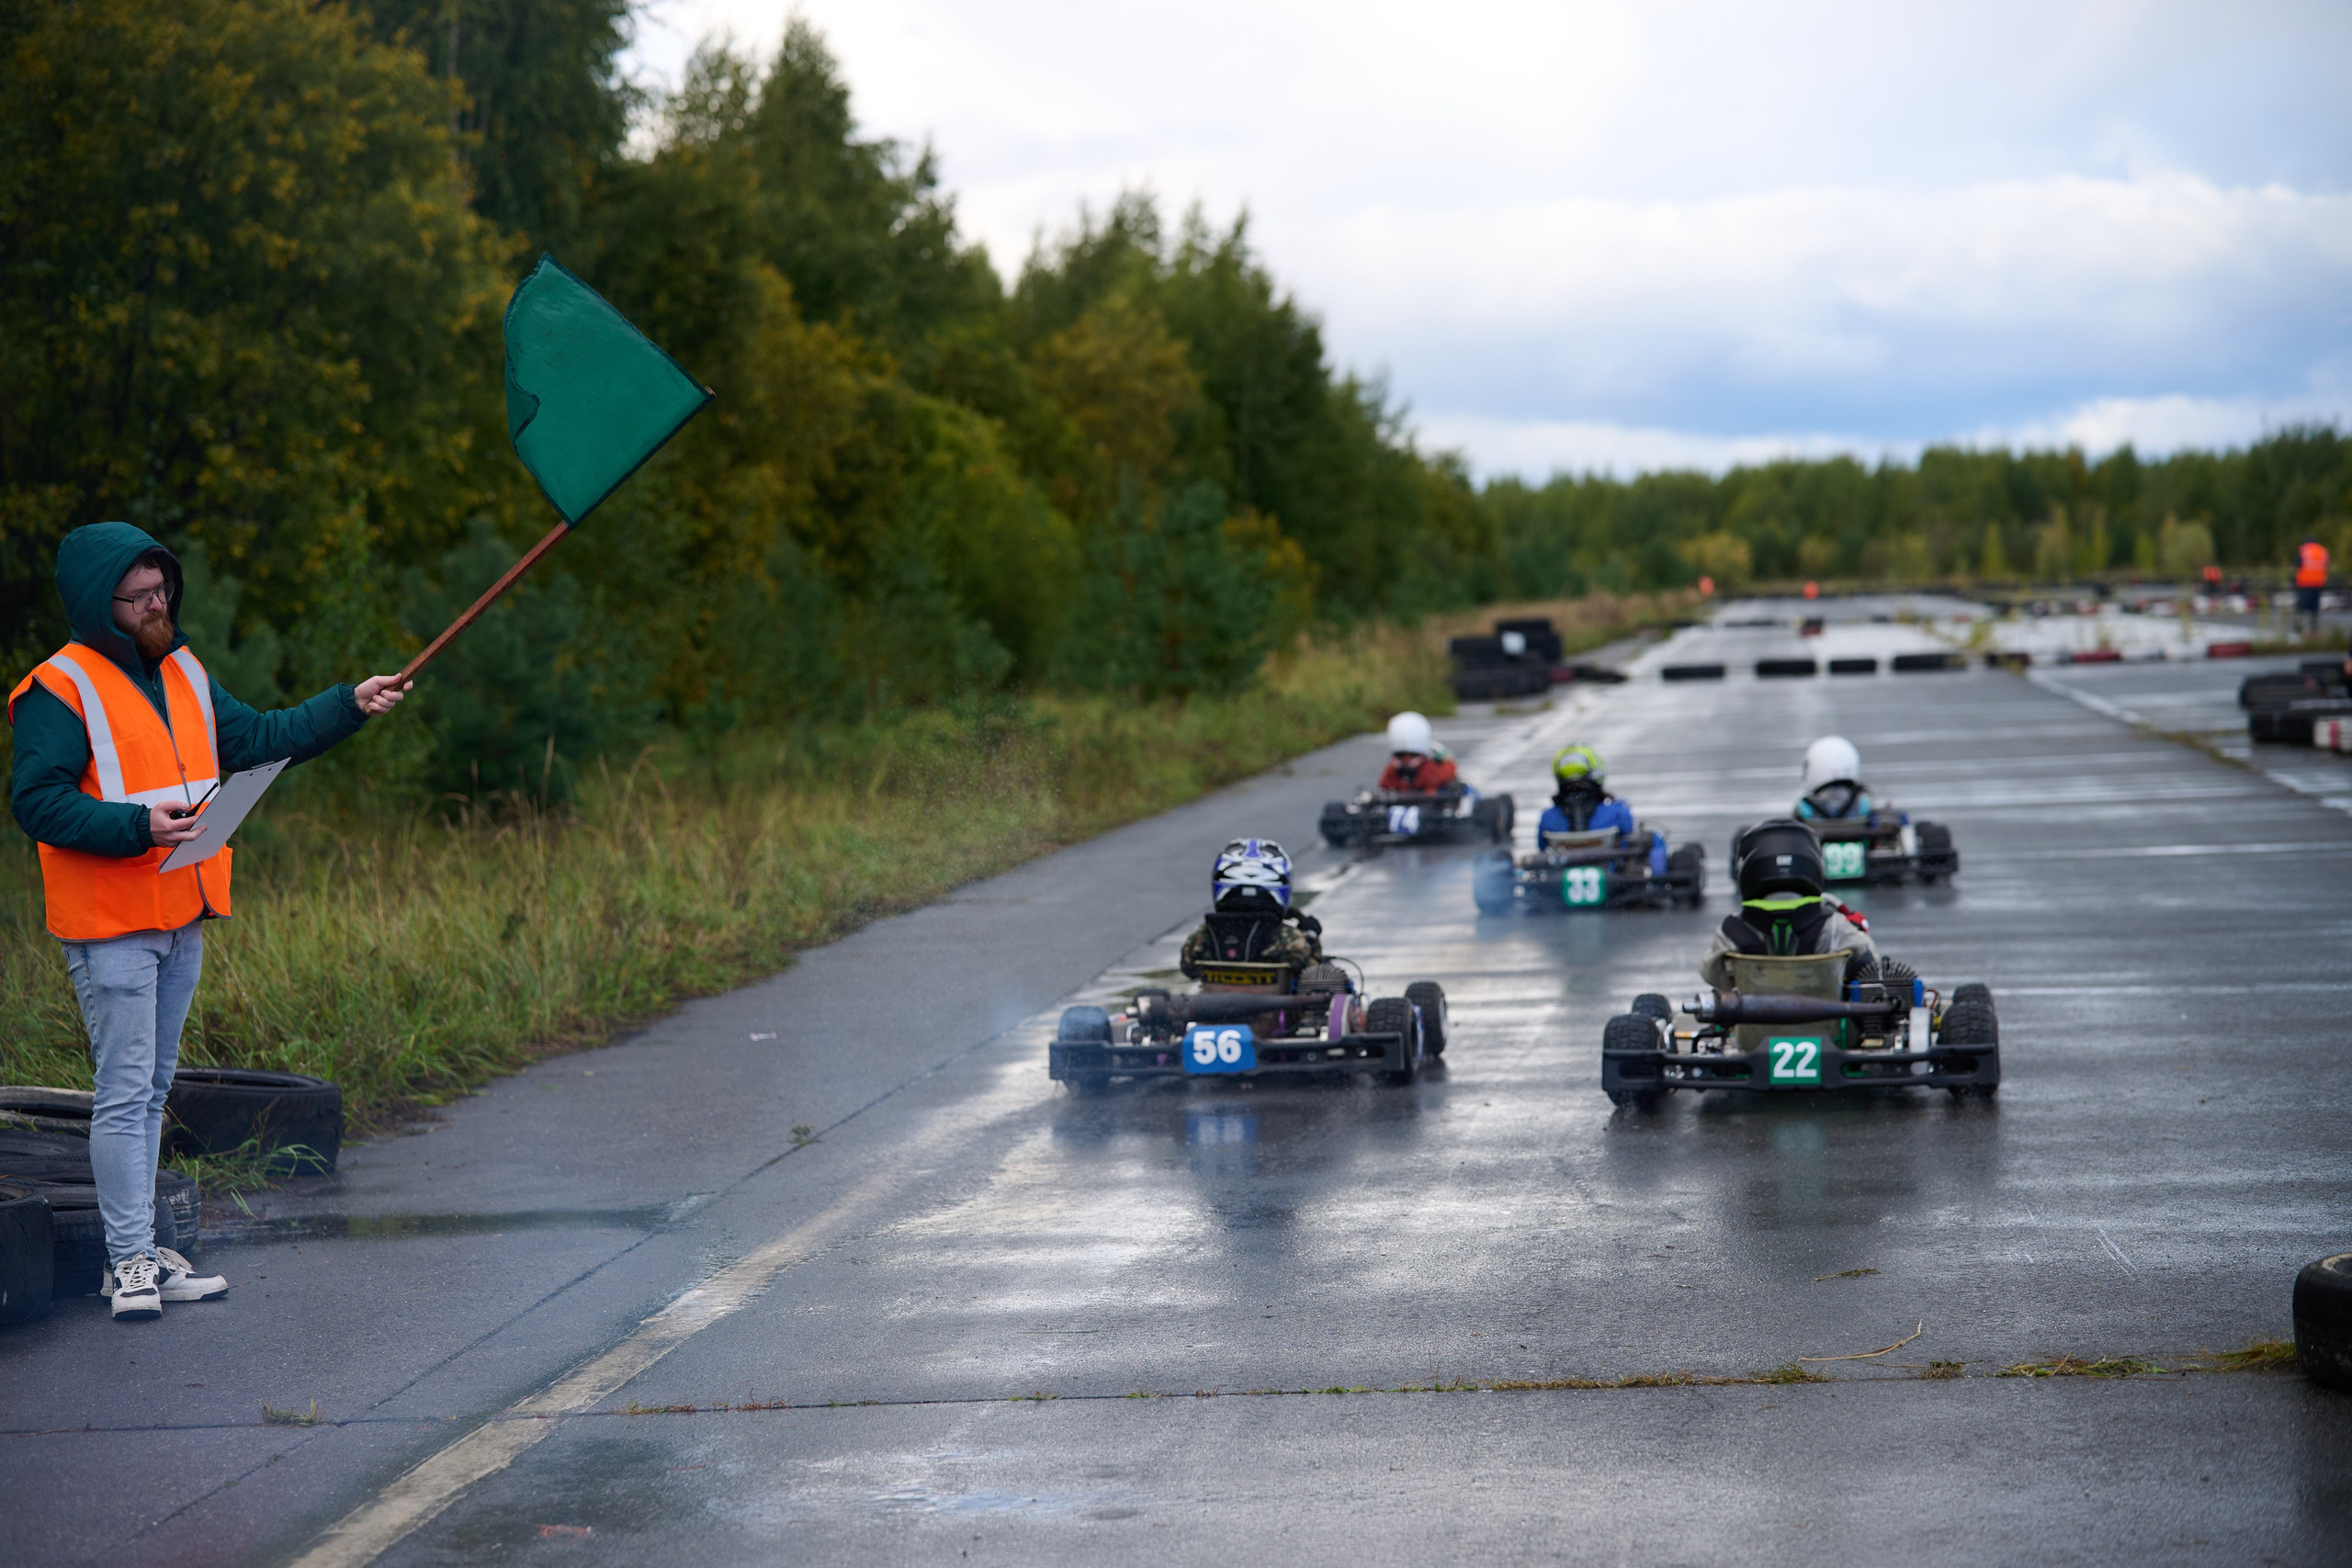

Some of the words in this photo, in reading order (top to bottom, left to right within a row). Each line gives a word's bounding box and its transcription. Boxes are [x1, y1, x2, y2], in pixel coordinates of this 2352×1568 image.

[1389, 805, 1419, 834] 74
[1566, 867, 1600, 903] 33
[1193, 1029, 1242, 1065] 56
[1773, 1042, 1817, 1078] 22
